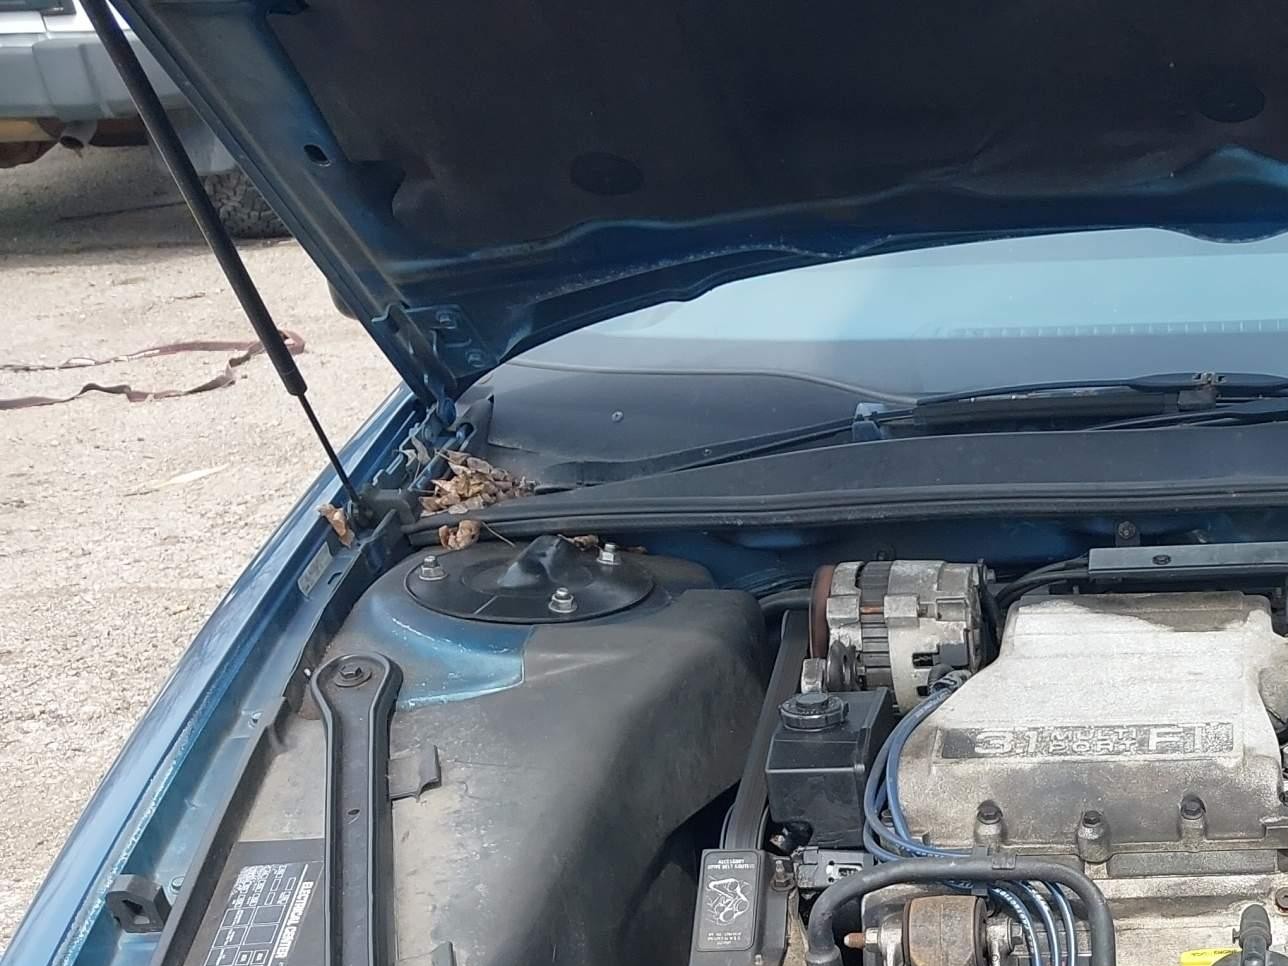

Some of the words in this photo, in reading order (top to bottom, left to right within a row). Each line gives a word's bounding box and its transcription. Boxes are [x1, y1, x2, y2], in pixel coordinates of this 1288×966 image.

[1051, 728, 1136, 740] MULTI
[1049, 740, 1138, 752] PORT
[287, 881, 314, 926] ELECTRICAL
[275, 926, 296, 958] CENTER
